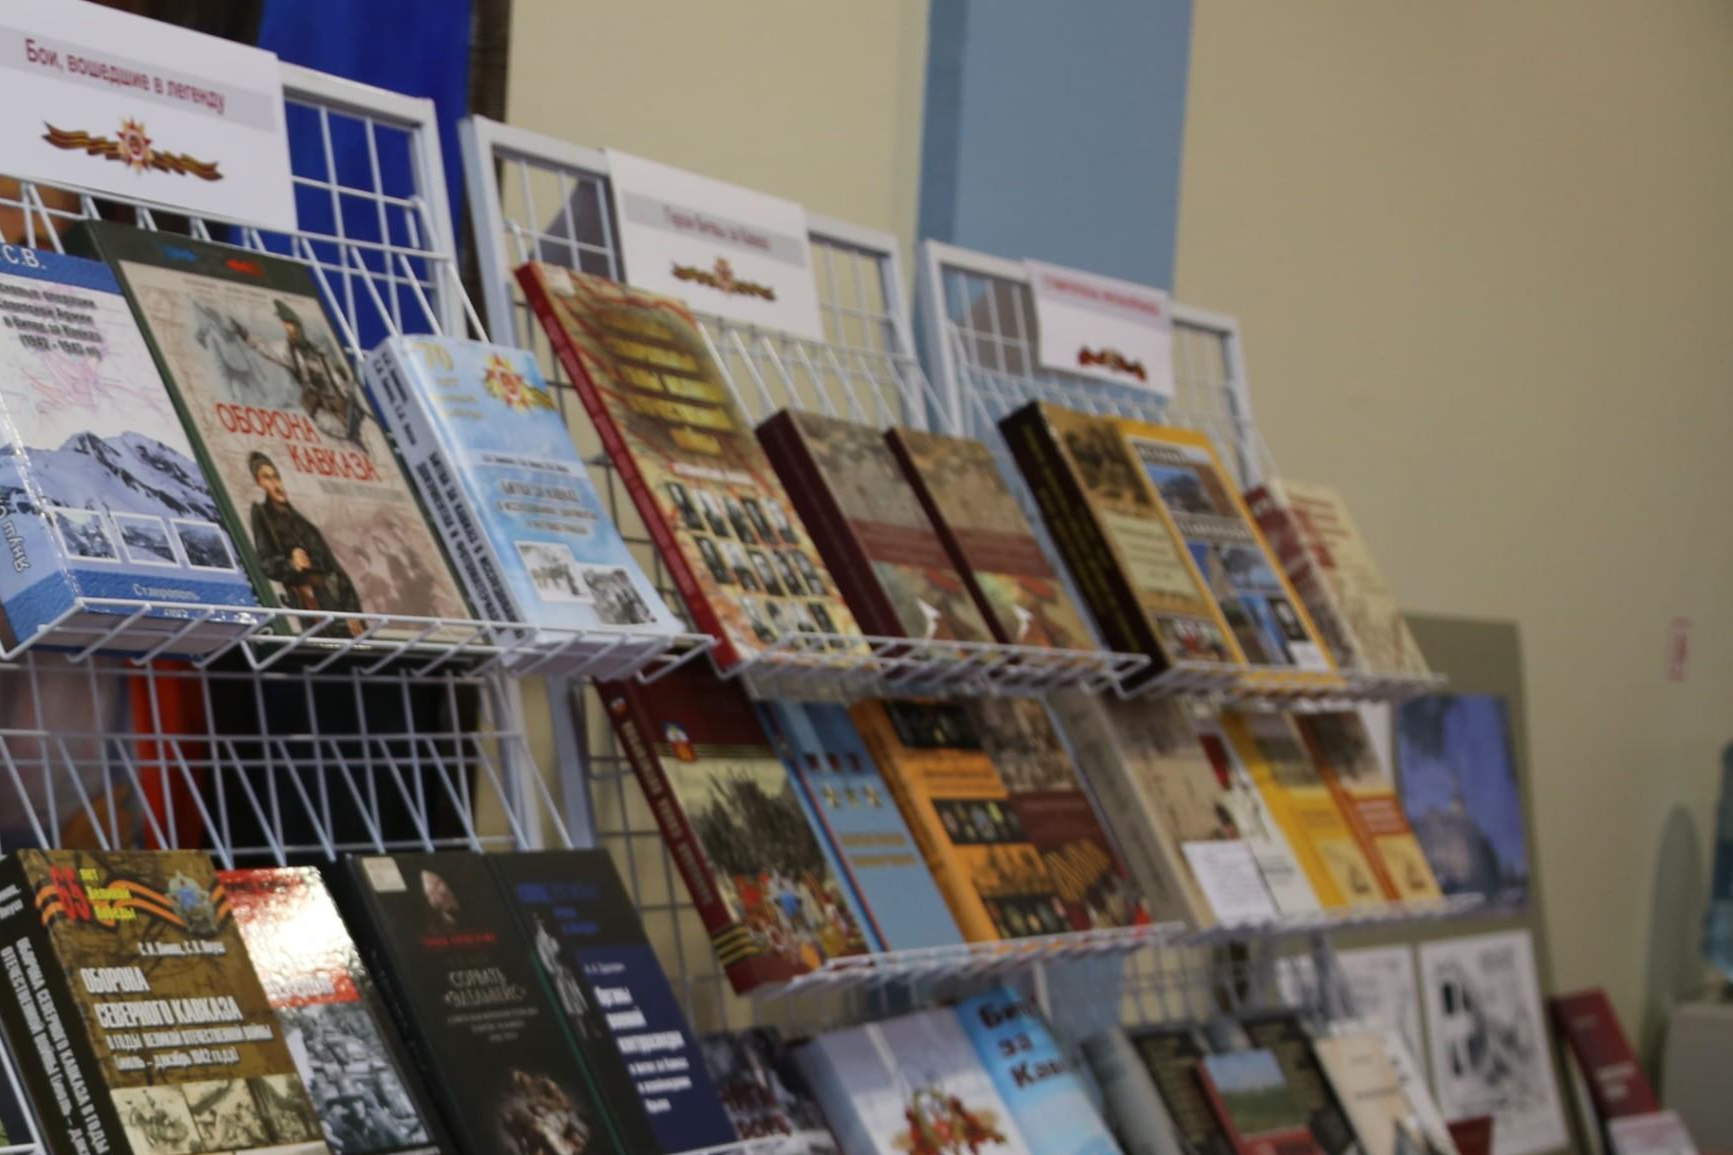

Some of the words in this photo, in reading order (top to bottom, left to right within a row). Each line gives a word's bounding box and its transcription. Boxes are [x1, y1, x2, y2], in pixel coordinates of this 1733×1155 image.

[24, 38, 64, 73] Бои,
[67, 54, 150, 91] вошедшие
[153, 78, 163, 94] в
[167, 81, 226, 116] легенду
[1, 244, 48, 271] С.В.
[215, 402, 322, 443] ОБОРОНА
[285, 443, 383, 484] КАВКАЗА
